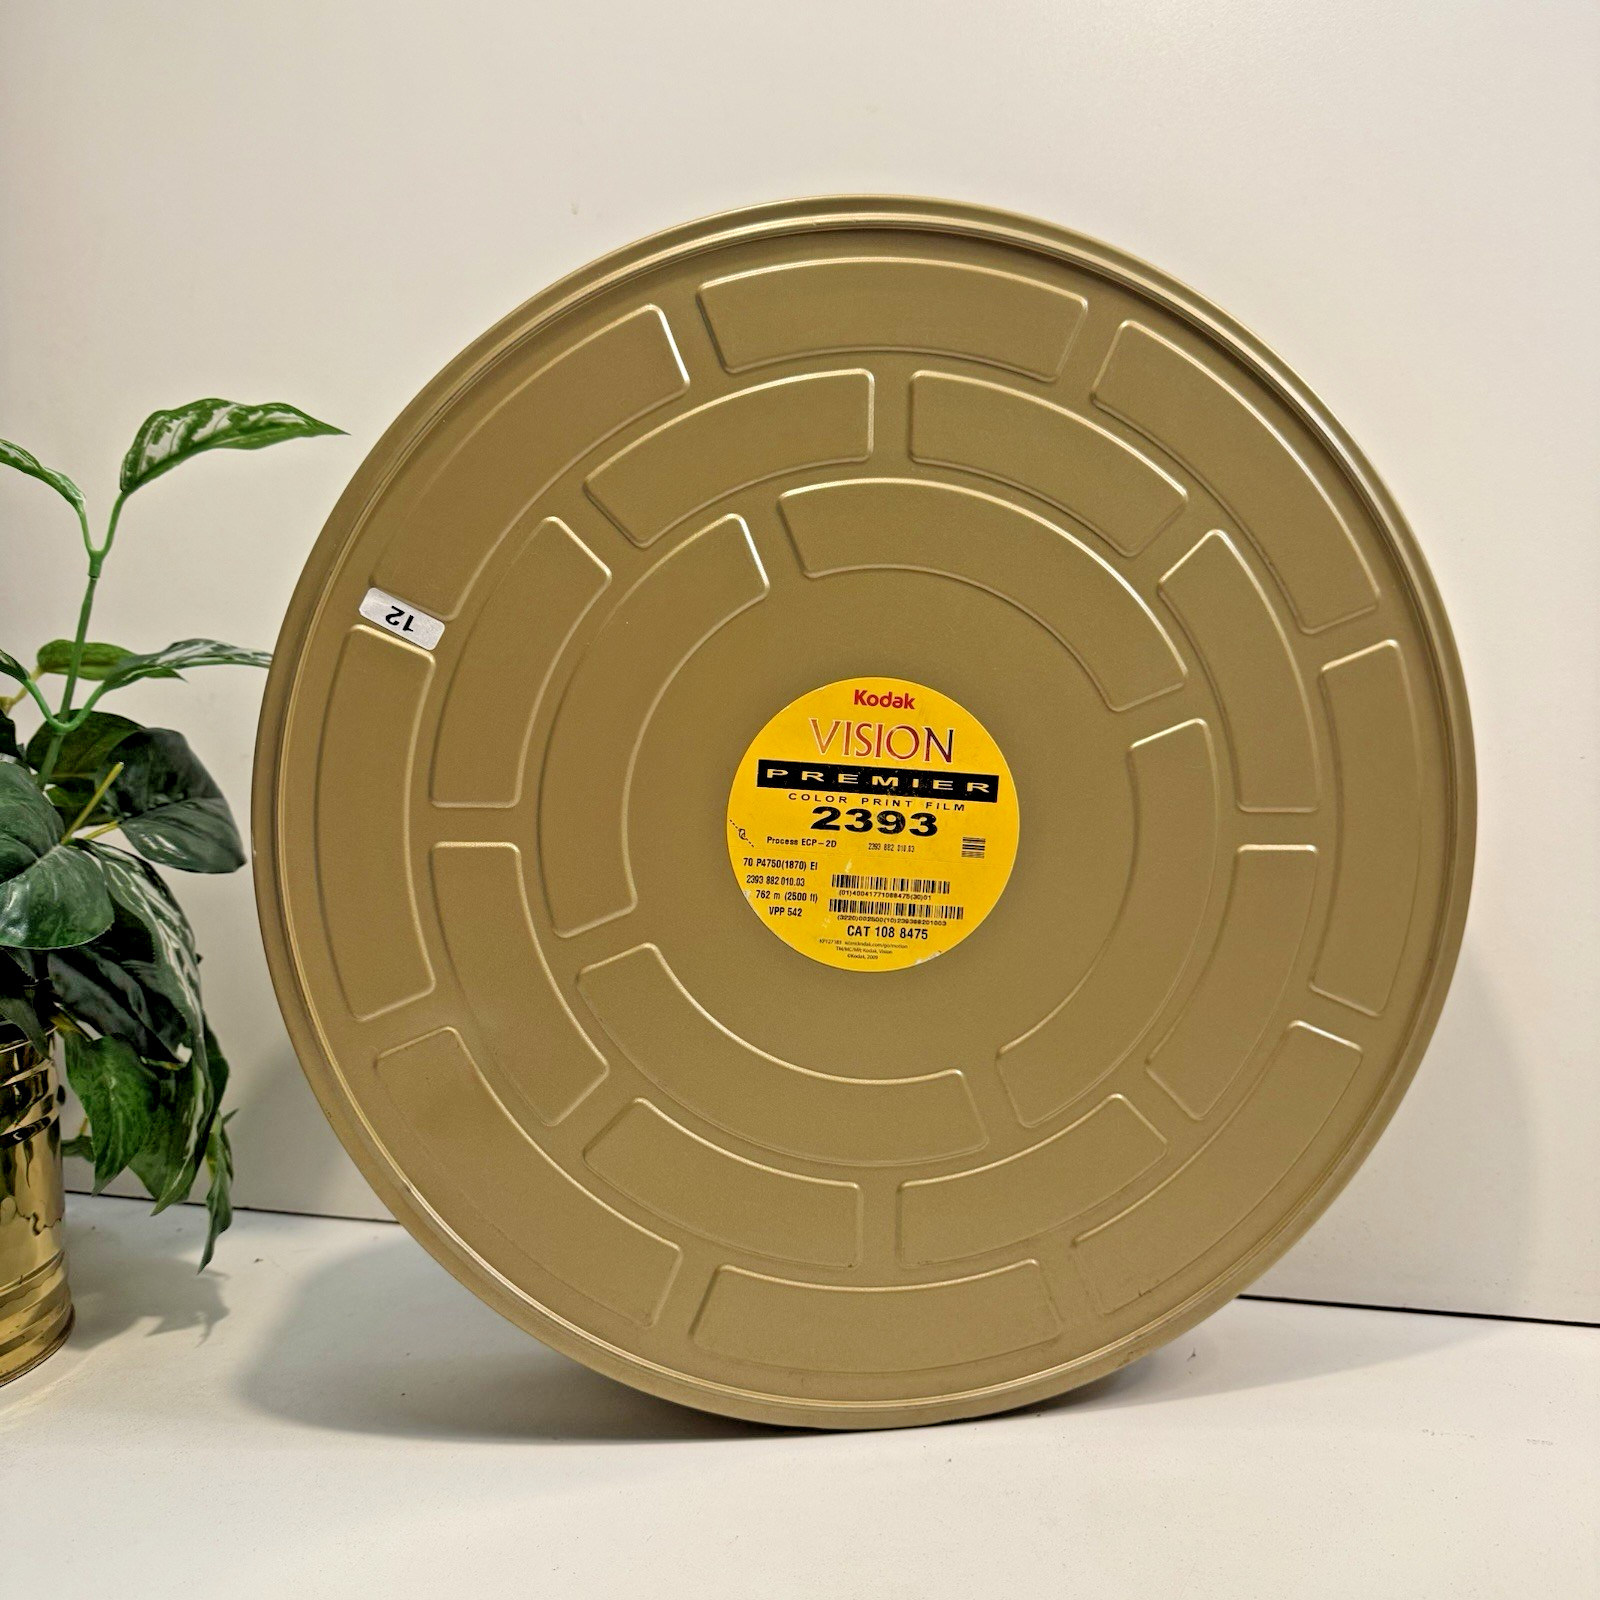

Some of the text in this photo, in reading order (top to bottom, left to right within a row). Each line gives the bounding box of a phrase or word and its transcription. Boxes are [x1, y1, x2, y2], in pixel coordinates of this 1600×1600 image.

[386, 605, 414, 632] 12
[853, 689, 916, 710] Kodak
[808, 717, 956, 764] VISION
[766, 768, 991, 794] PREMIER
[788, 792, 966, 812] COLOR PRINT FILM
[810, 806, 938, 837] 2393
[766, 836, 799, 846] Process
[743, 857, 754, 867] 70
[756, 858, 807, 871] P4750(1870)
[746, 874, 805, 887] 2393 882 010.03
[756, 889, 818, 904] 762 m (2500 ft)
[768, 906, 803, 917] VPP 542
[847, 924, 928, 940] CAT 108 8475
